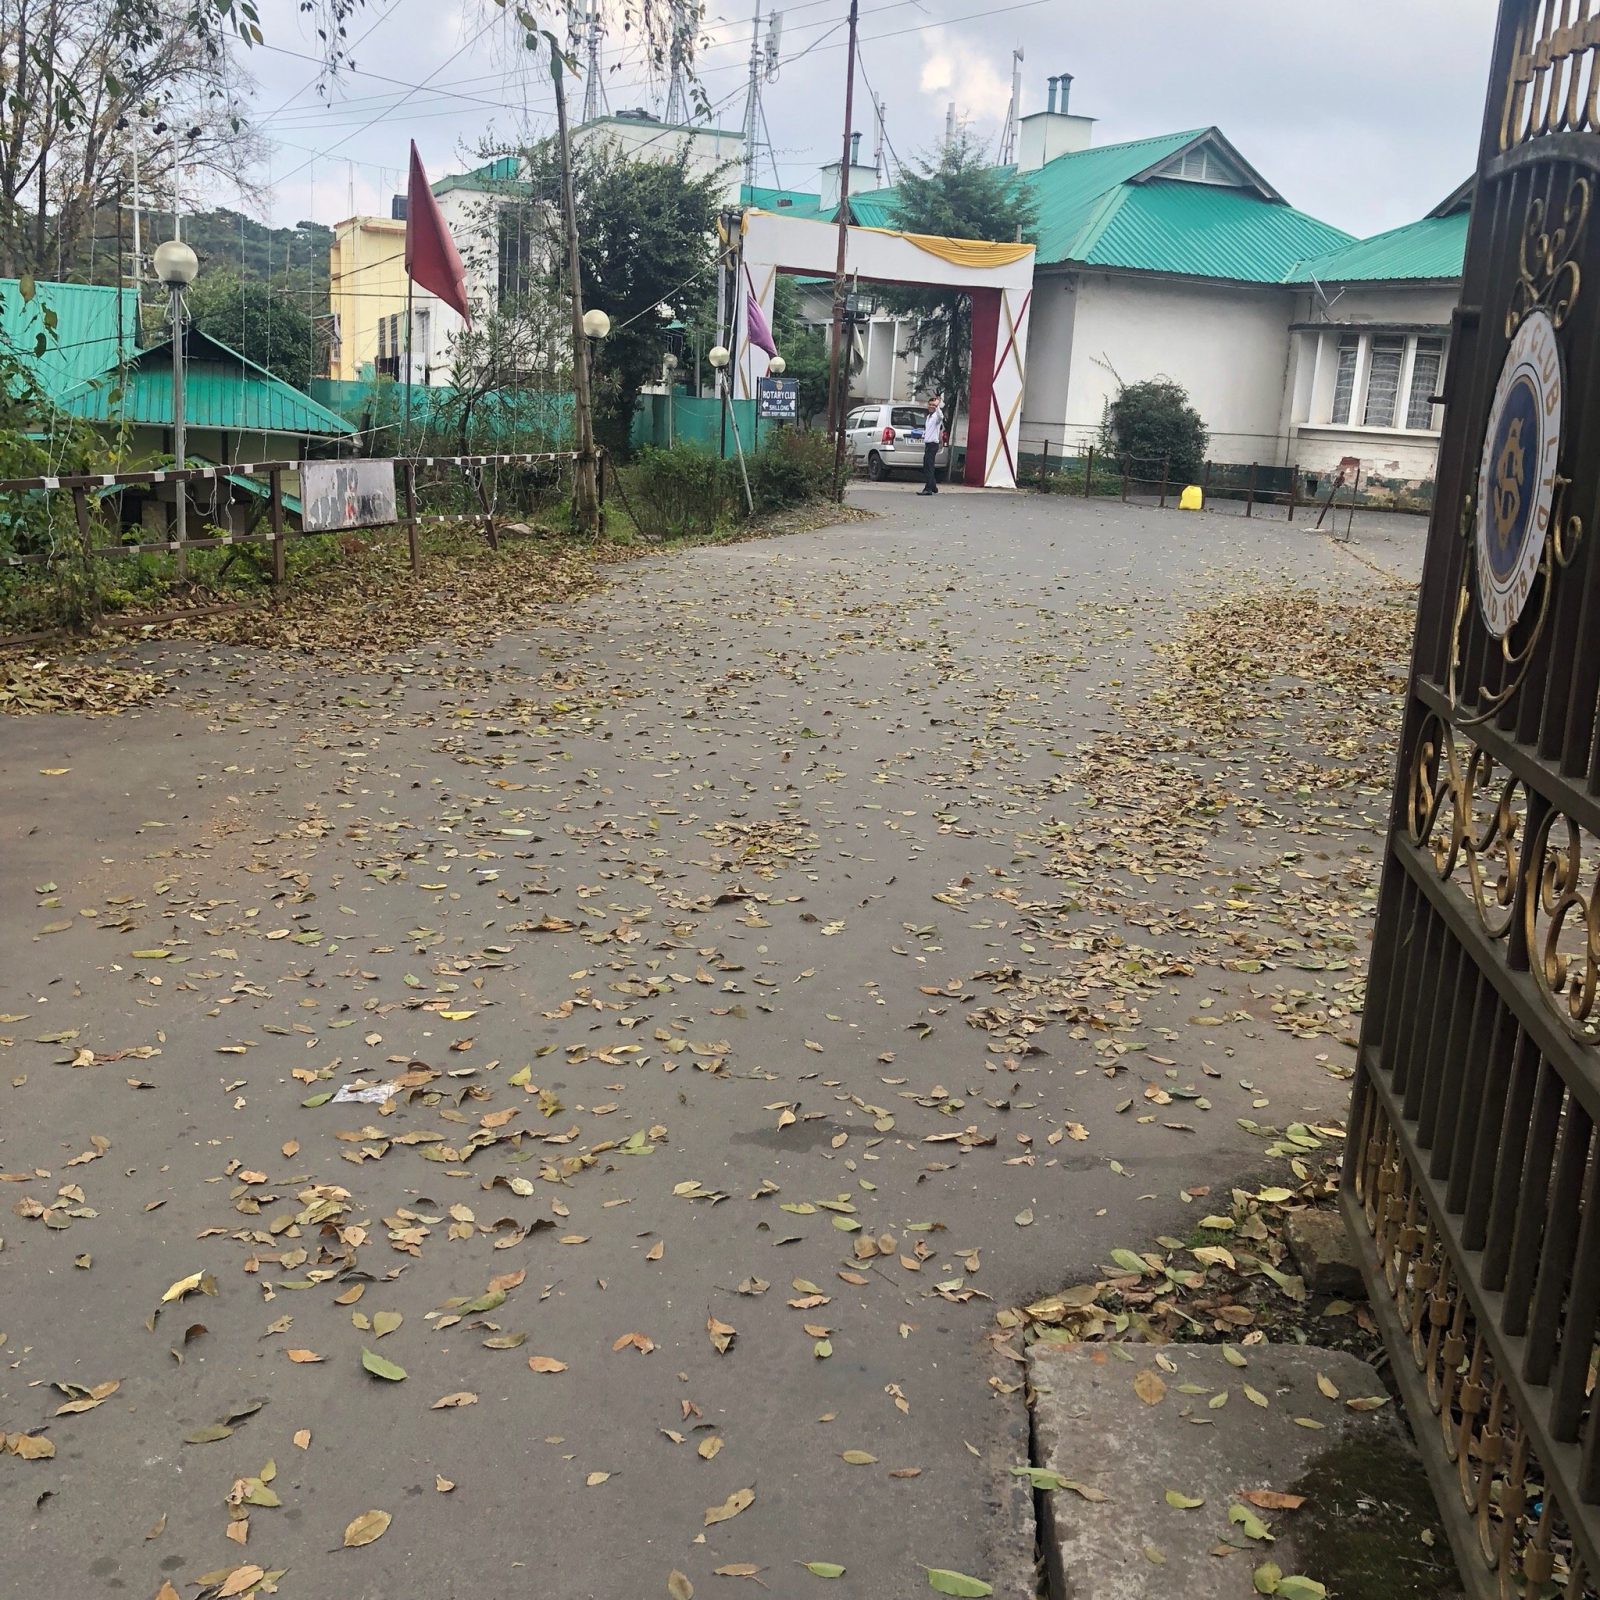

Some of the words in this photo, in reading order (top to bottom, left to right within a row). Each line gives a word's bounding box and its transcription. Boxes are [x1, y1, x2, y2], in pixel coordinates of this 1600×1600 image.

[762, 390, 785, 400] ROTARY
[784, 391, 796, 400] CLUB
[1530, 321, 1560, 417] CLUB
[1502, 570, 1528, 626] 1878
